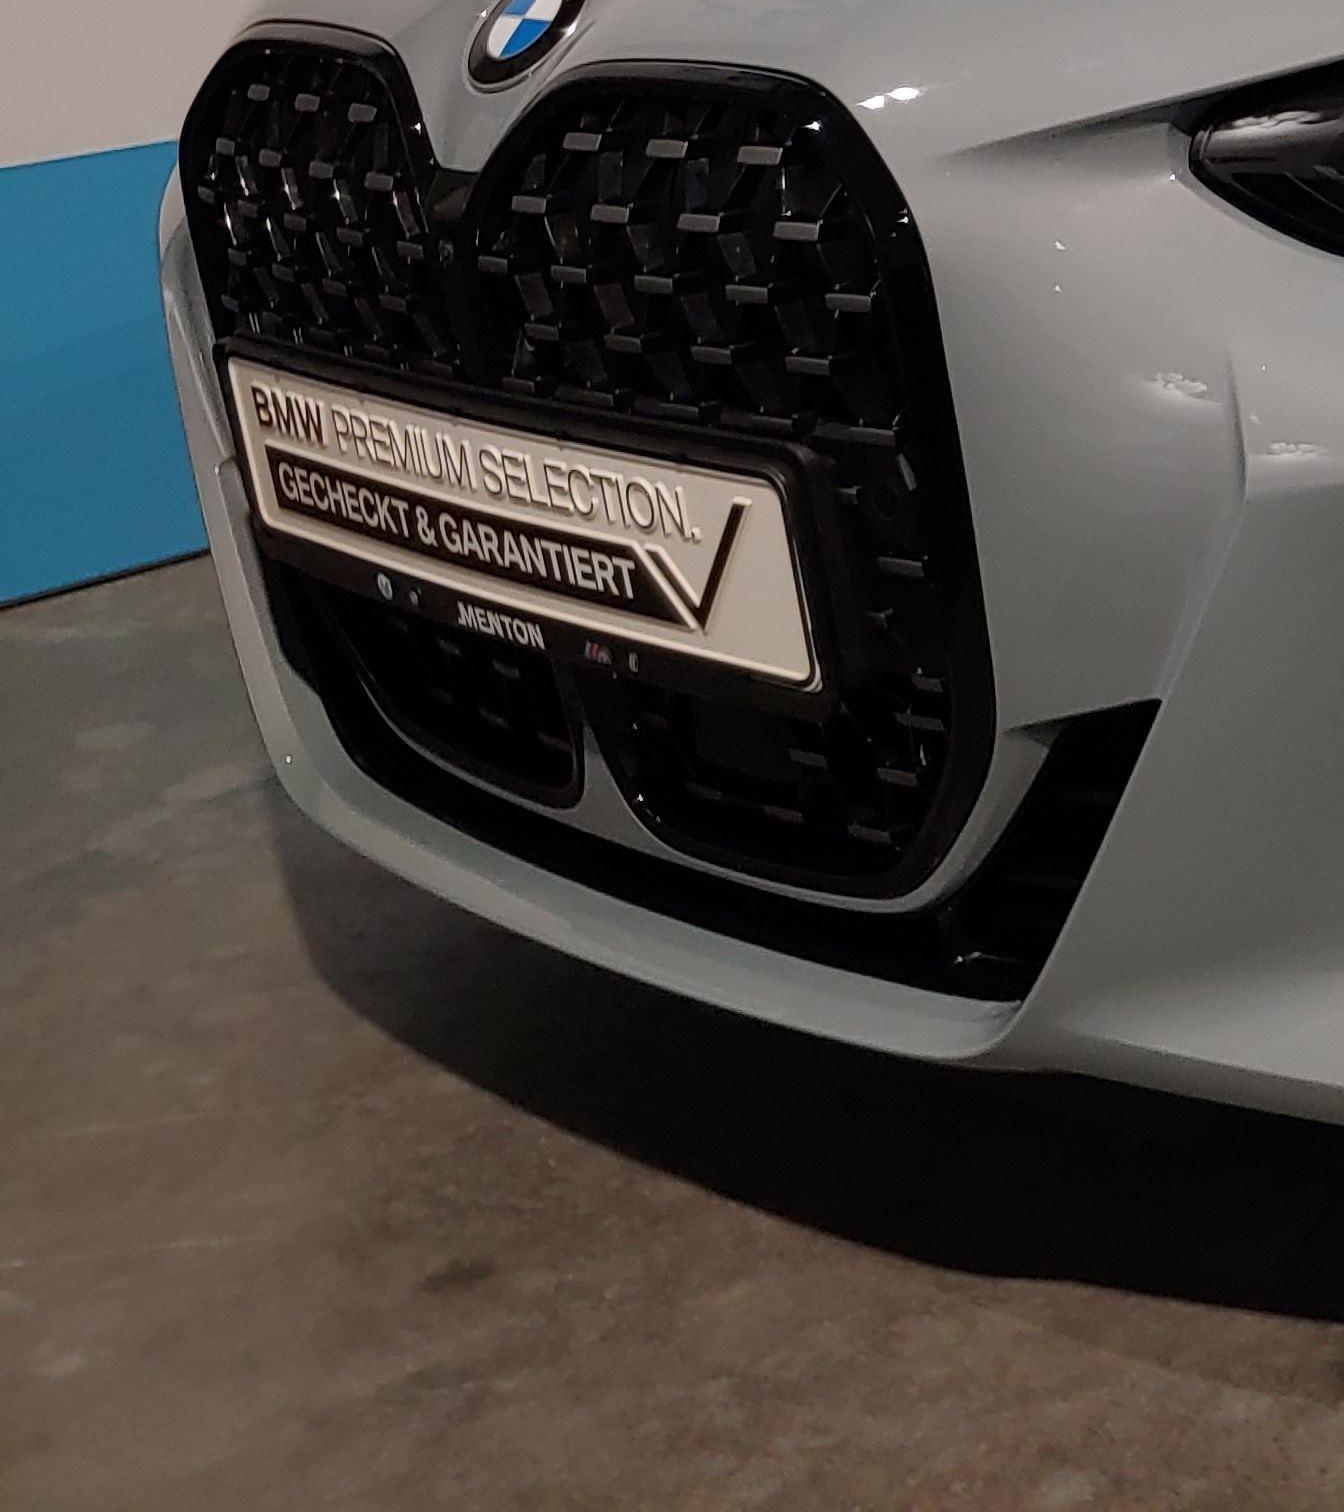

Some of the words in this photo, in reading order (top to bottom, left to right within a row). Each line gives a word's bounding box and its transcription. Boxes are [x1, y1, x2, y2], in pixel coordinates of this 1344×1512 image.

[251, 380, 328, 446] BMW
[332, 403, 478, 492] PREMIUM
[278, 461, 410, 538] GECHECKT
[415, 505, 439, 546] &
[439, 512, 636, 599] GARANTIERT
[457, 600, 546, 650] MENTON
